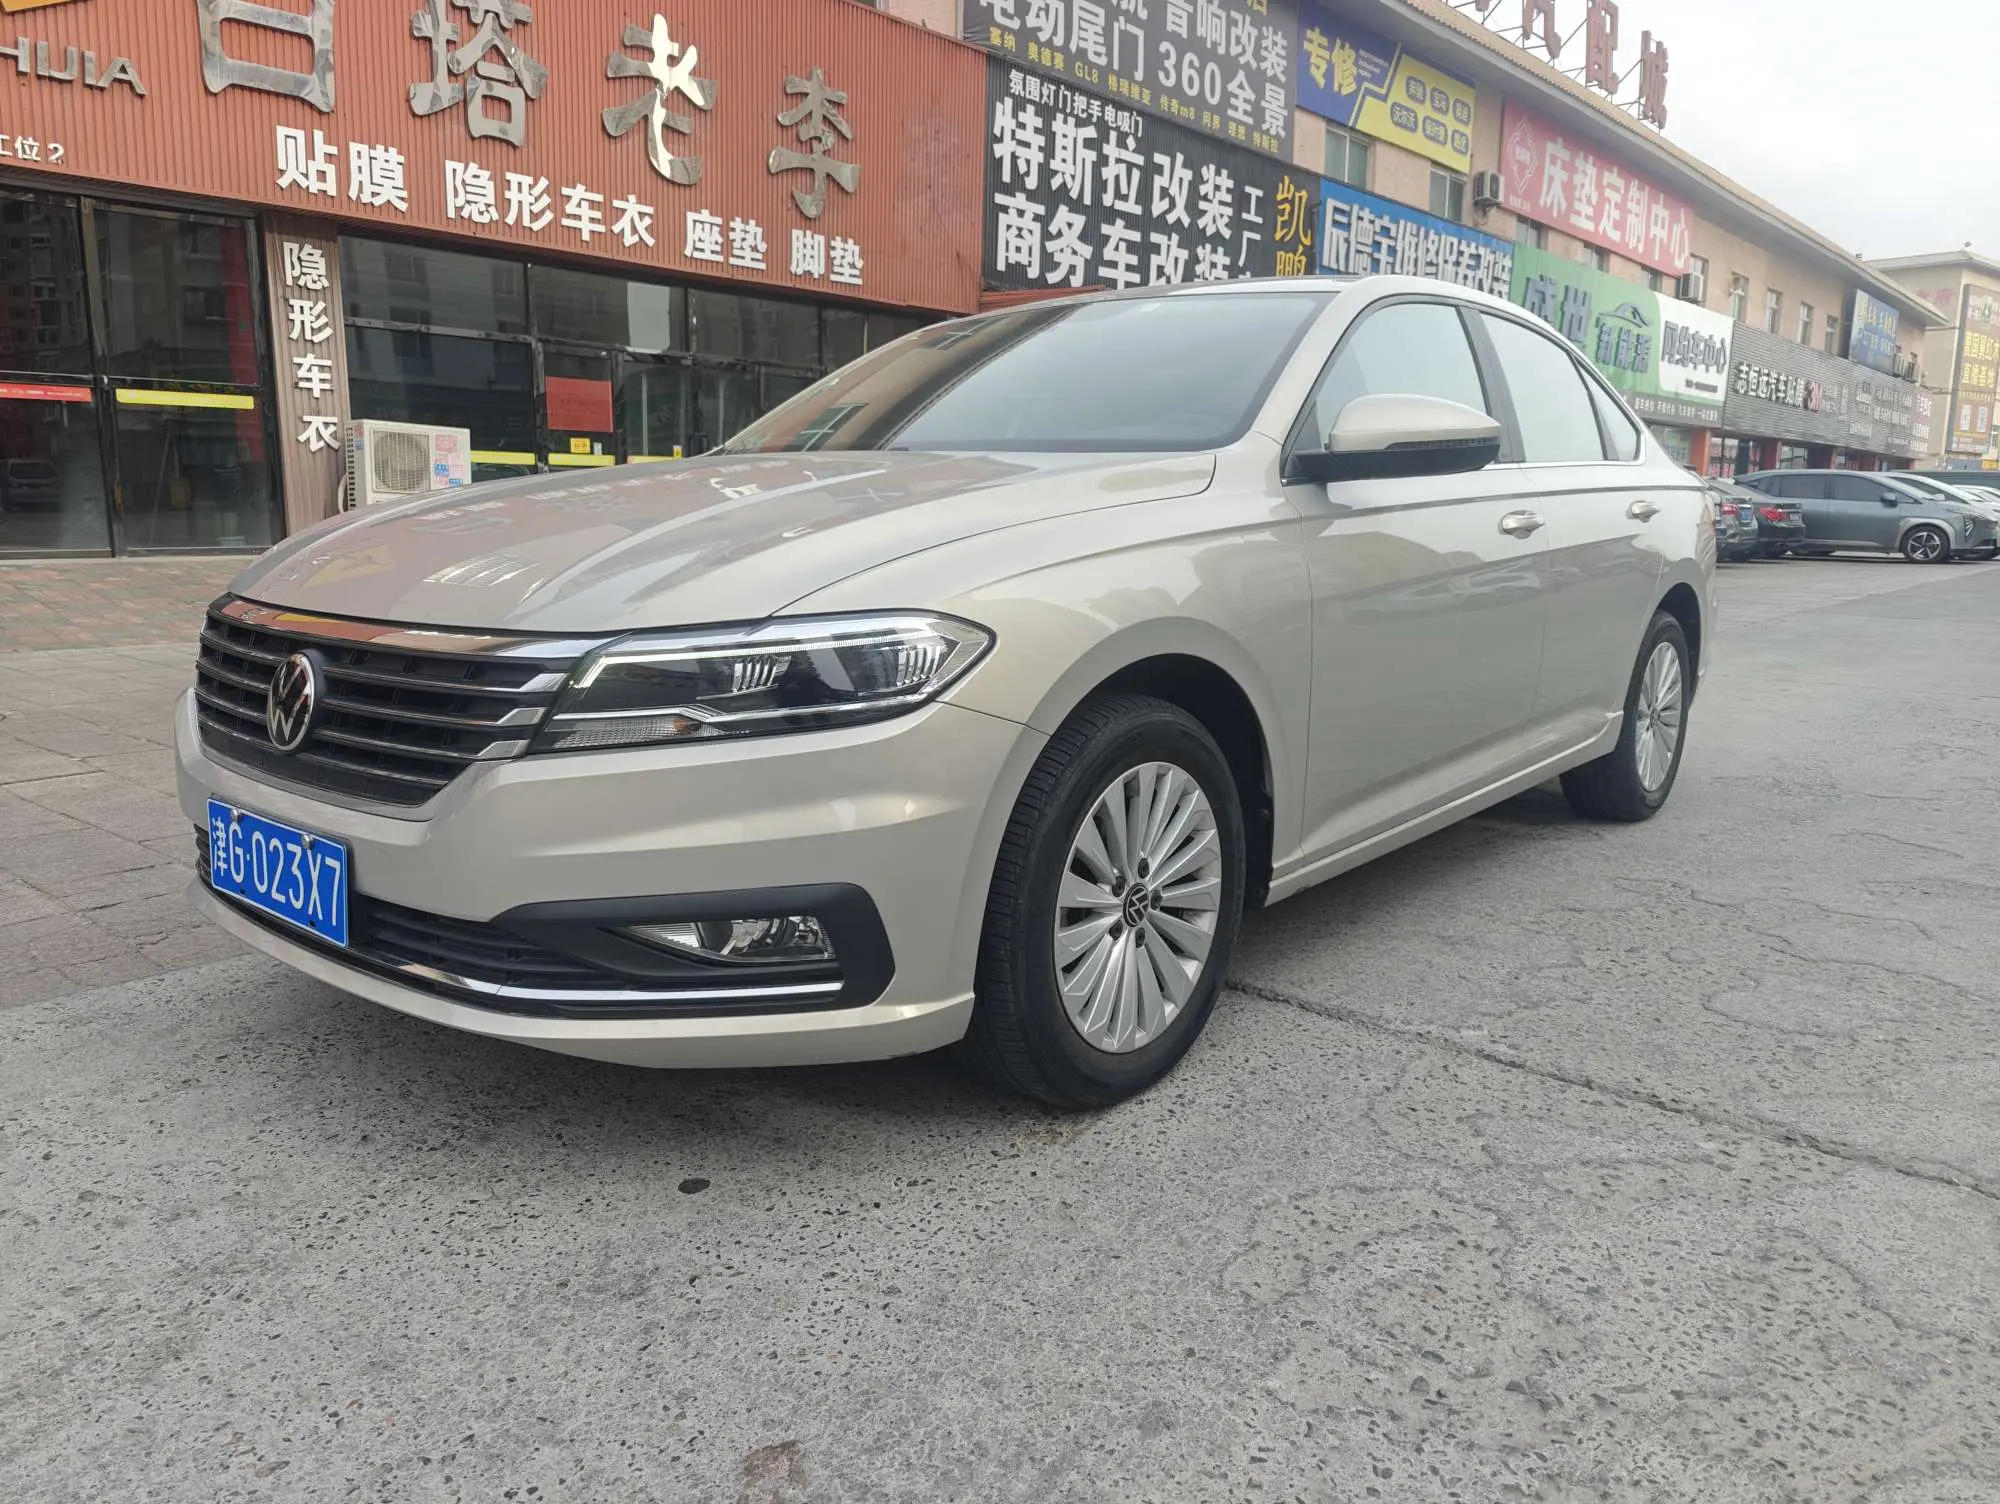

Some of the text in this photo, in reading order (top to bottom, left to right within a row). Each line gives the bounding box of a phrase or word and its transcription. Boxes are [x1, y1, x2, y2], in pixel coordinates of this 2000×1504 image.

[1074, 61, 1099, 84] GL8
[1303, 26, 1358, 96] 专修
[275, 125, 864, 286] 贴膜 隐形车衣 座垫 脚垫
[991, 96, 1235, 241] 特斯拉改装
[1539, 137, 1691, 270] 床垫定制中心
[282, 241, 342, 453] 隐形车衣
